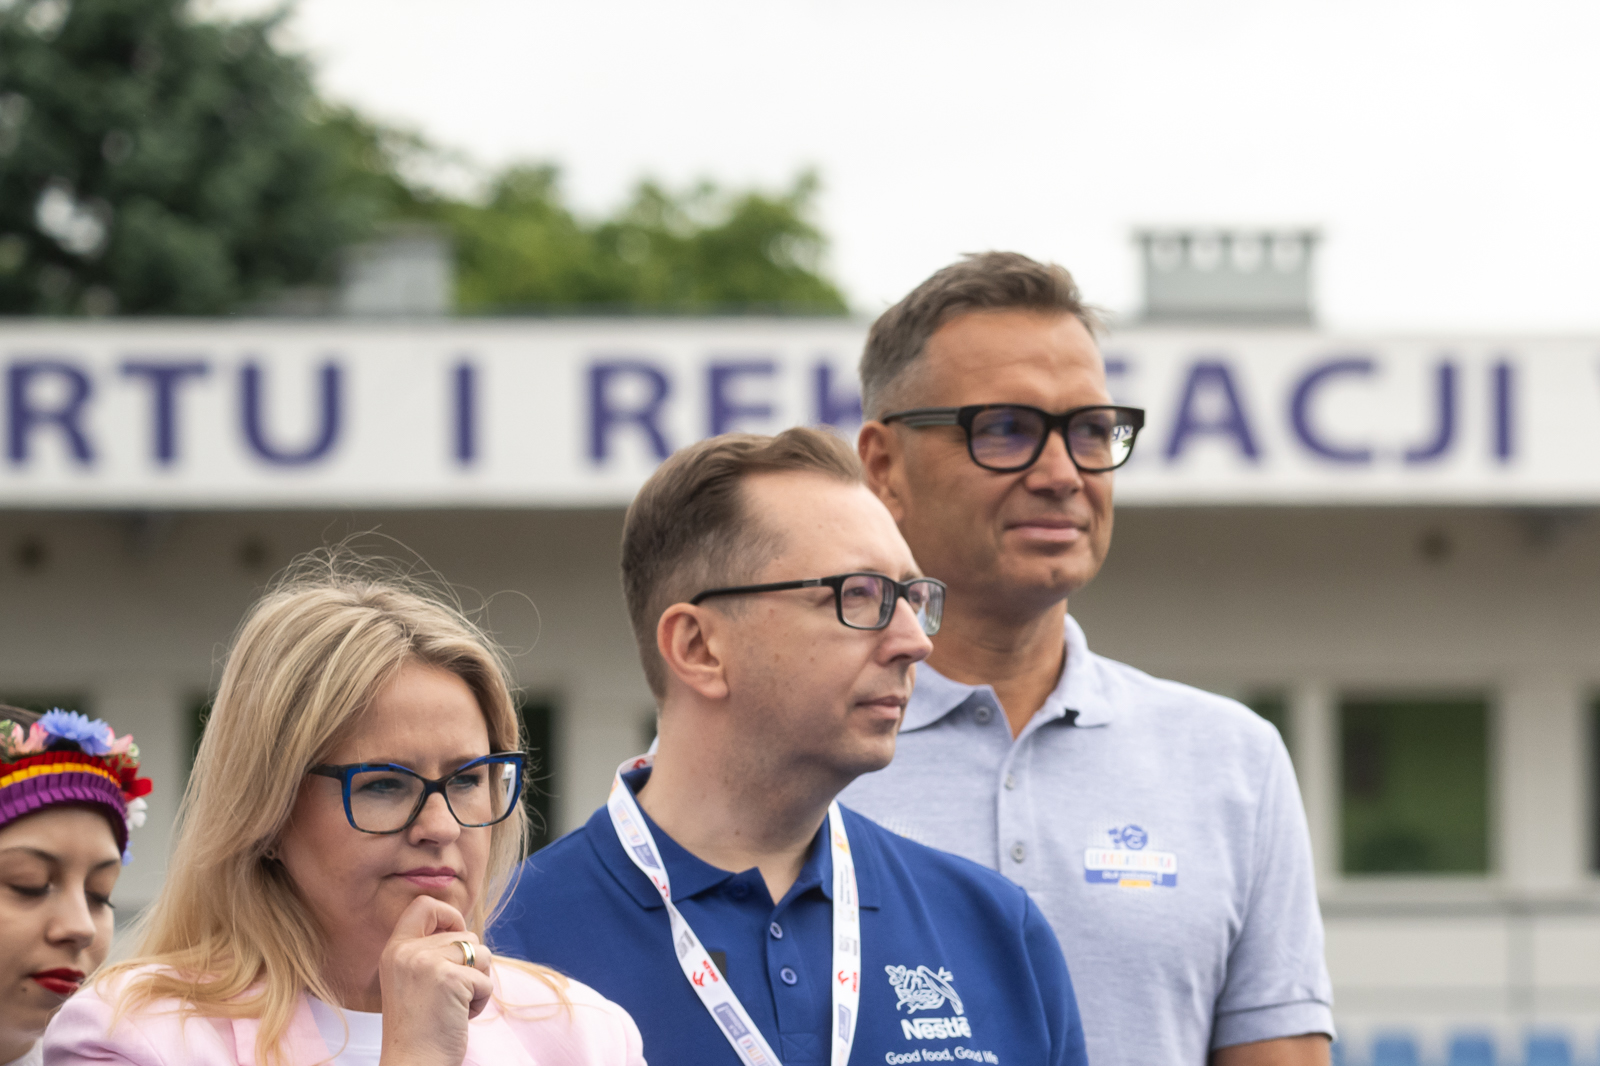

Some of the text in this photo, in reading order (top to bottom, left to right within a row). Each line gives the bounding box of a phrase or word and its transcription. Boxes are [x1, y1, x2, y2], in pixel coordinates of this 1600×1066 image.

[5, 358, 347, 468] RTU
[449, 358, 482, 467] I
[583, 355, 1521, 467] REACJI
[885, 1046, 999, 1065] Good food, Good life
